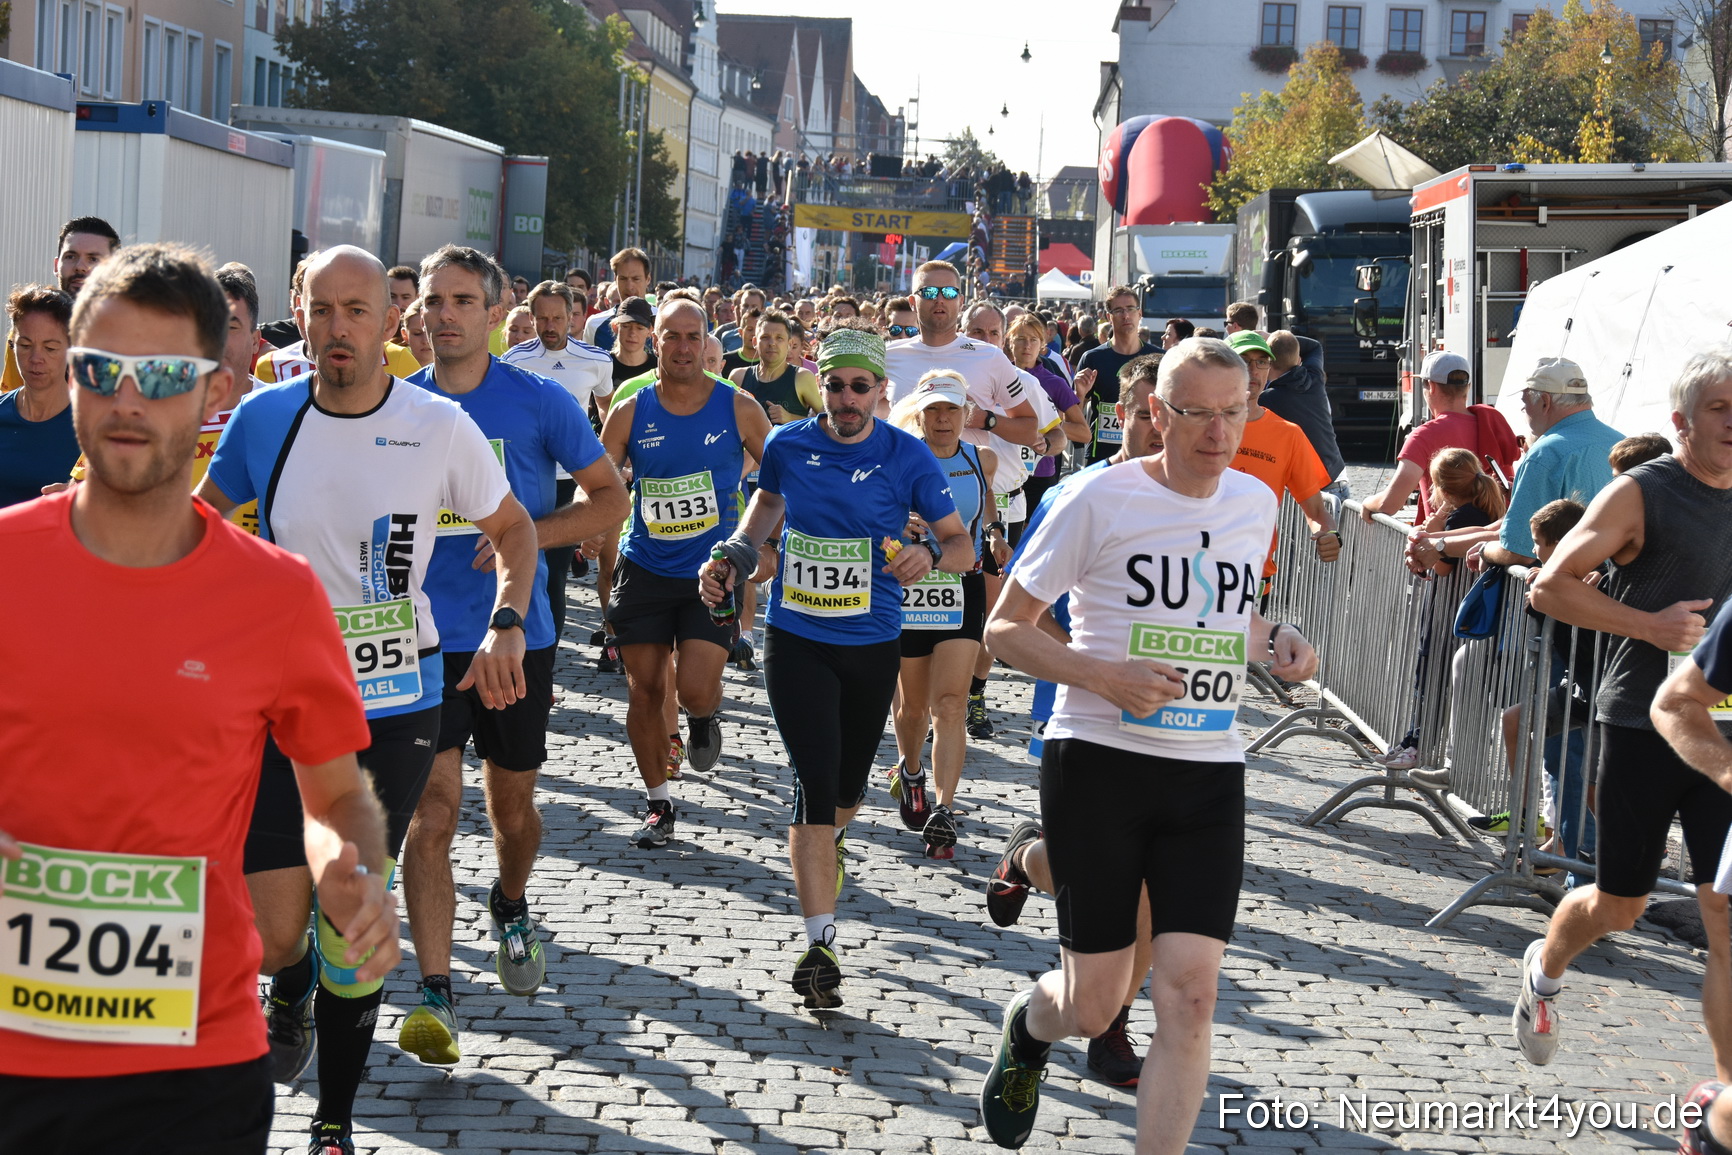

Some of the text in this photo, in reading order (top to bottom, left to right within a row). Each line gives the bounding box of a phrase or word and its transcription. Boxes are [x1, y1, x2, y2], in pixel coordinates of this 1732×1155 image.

[467, 192, 493, 237] BOCK
[852, 212, 912, 229] START
[1161, 250, 1208, 258] BOCK
[642, 441, 660, 449] FEHR
[646, 475, 708, 495] BOCK
[650, 496, 709, 520] 1133
[659, 521, 706, 534] JOCHEN
[385, 513, 418, 600] HUB
[791, 533, 864, 560] BOCK
[359, 541, 372, 604] WASTE WATER
[792, 561, 860, 590] 1134
[790, 591, 861, 607] JOHANNES
[901, 588, 955, 607] 2268
[905, 613, 949, 622] MARION
[343, 637, 403, 674] 95
[1139, 628, 1238, 660] BOCK
[1161, 710, 1207, 728] ROLF
[3, 852, 185, 907] BOCK
[7, 912, 174, 977] 1204
[183, 929, 192, 939] B
[12, 985, 156, 1020] DOMINIK
